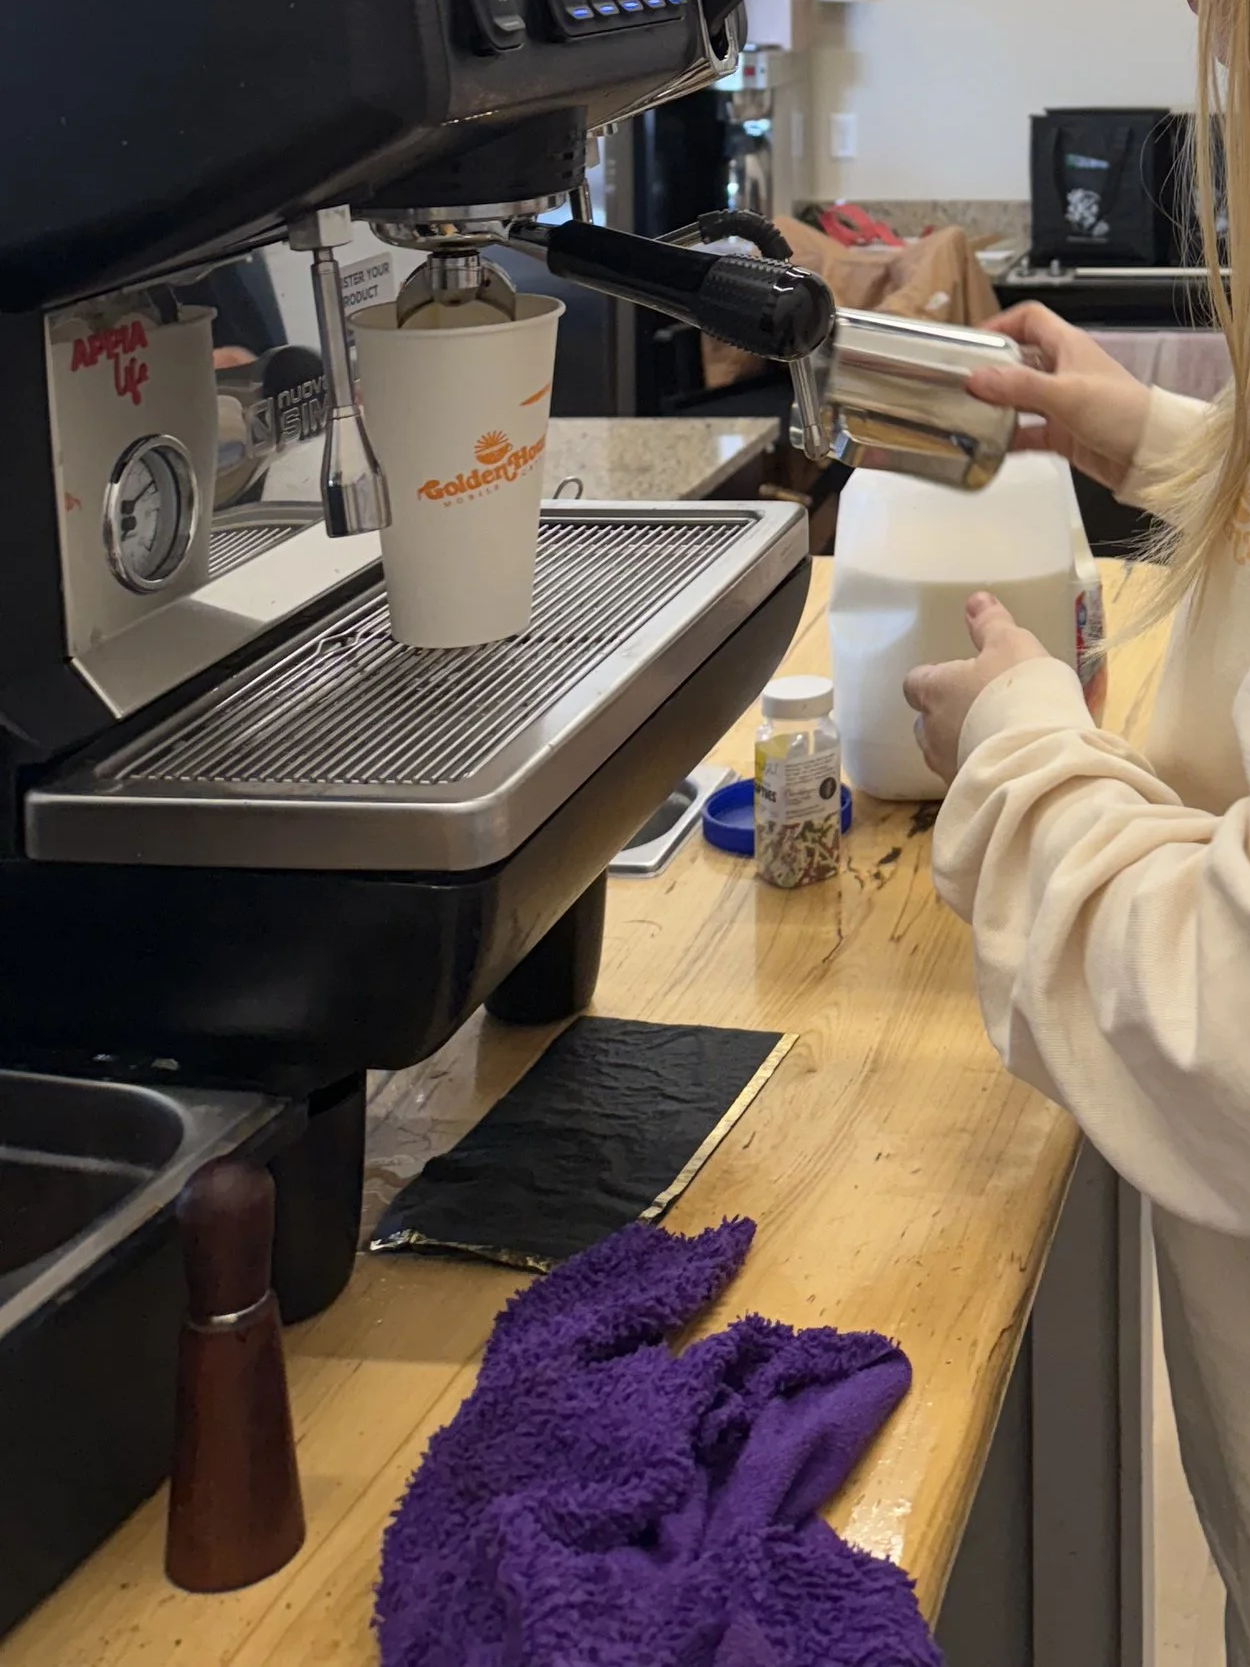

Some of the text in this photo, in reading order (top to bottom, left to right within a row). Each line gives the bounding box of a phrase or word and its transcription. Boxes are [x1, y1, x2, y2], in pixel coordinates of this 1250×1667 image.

[342, 262, 390, 289] STER YOUR
[342, 285, 379, 306] RODUCT
[71, 320, 148, 372] APPIA
[280, 396, 329, 445] SIM
[417, 460, 508, 501] Golden
